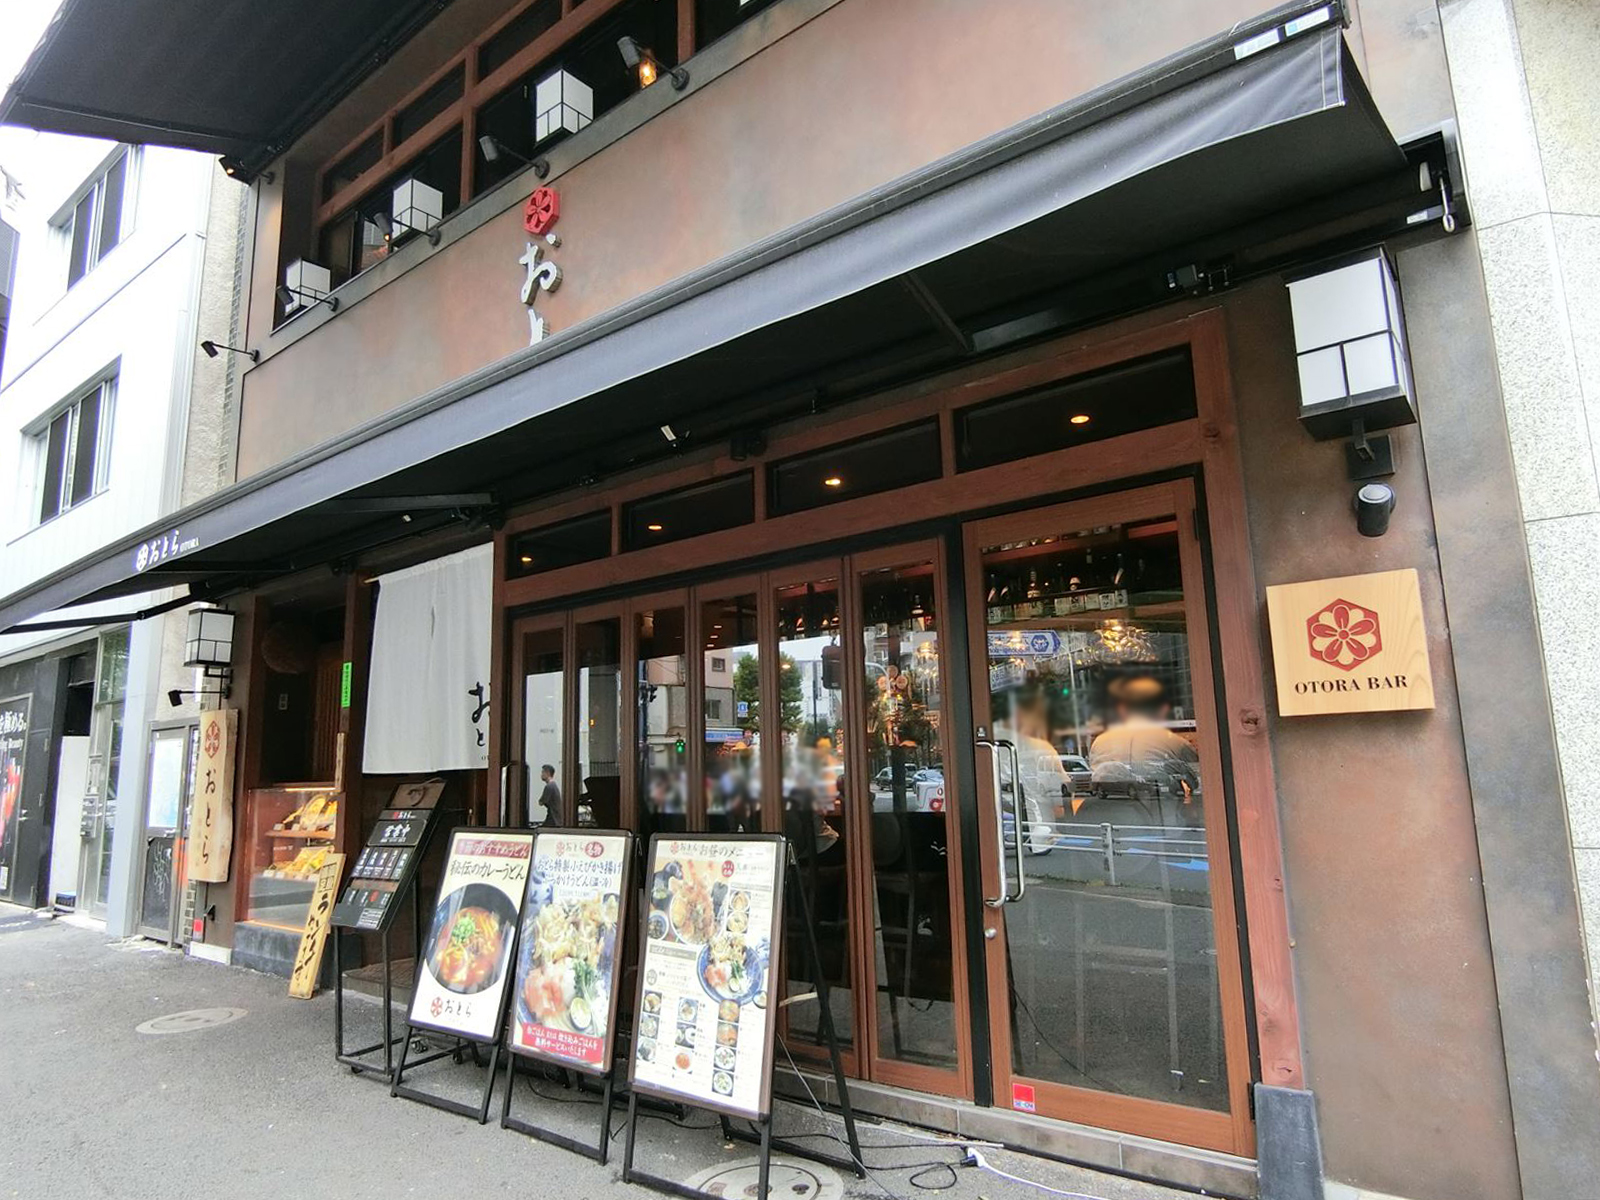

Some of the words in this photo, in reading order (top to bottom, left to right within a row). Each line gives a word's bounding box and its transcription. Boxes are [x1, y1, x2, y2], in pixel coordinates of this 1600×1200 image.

[148, 530, 180, 566] おとら
[1294, 678, 1361, 695] OTORA
[1367, 675, 1408, 690] BAR
[202, 768, 217, 864] おとら
[450, 859, 525, 881] 秘伝のカレーうどん
[445, 999, 472, 1018] おとら
